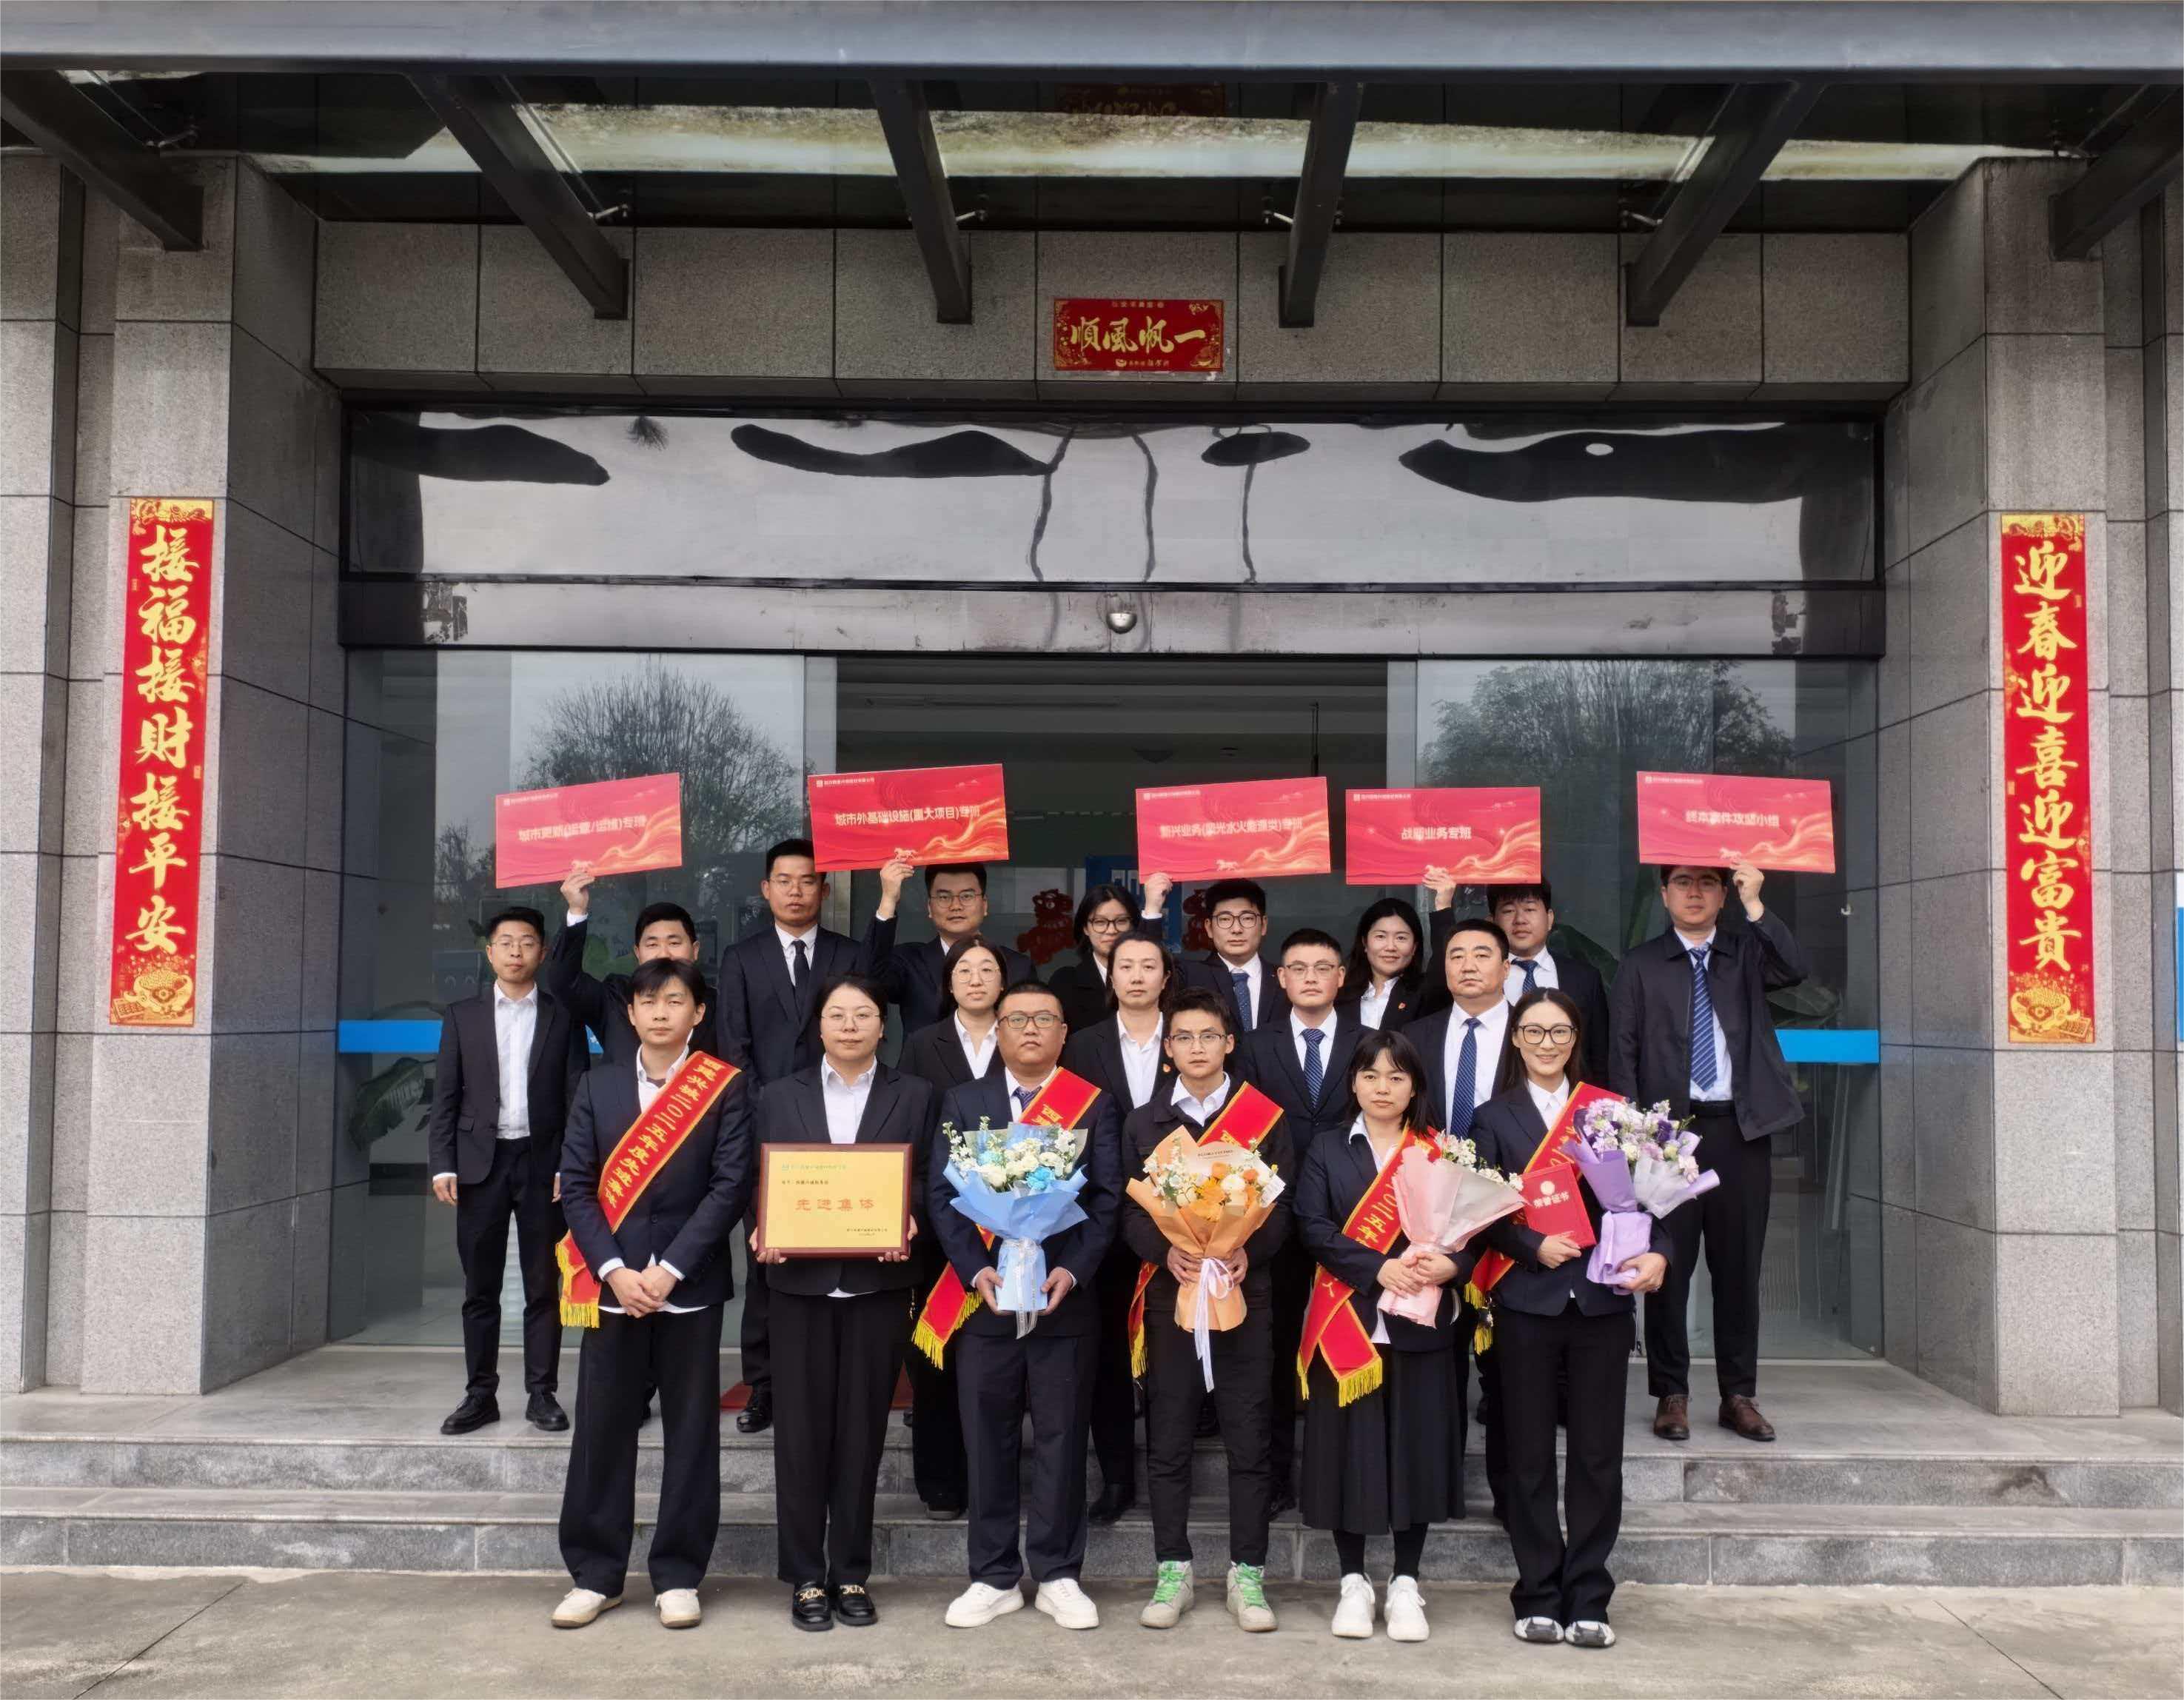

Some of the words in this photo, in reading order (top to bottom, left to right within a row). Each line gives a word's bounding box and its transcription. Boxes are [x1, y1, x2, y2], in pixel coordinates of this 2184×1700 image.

[2013, 540, 2083, 972] 迎春迎喜迎富貴
[795, 1197, 875, 1214] 先进集体
